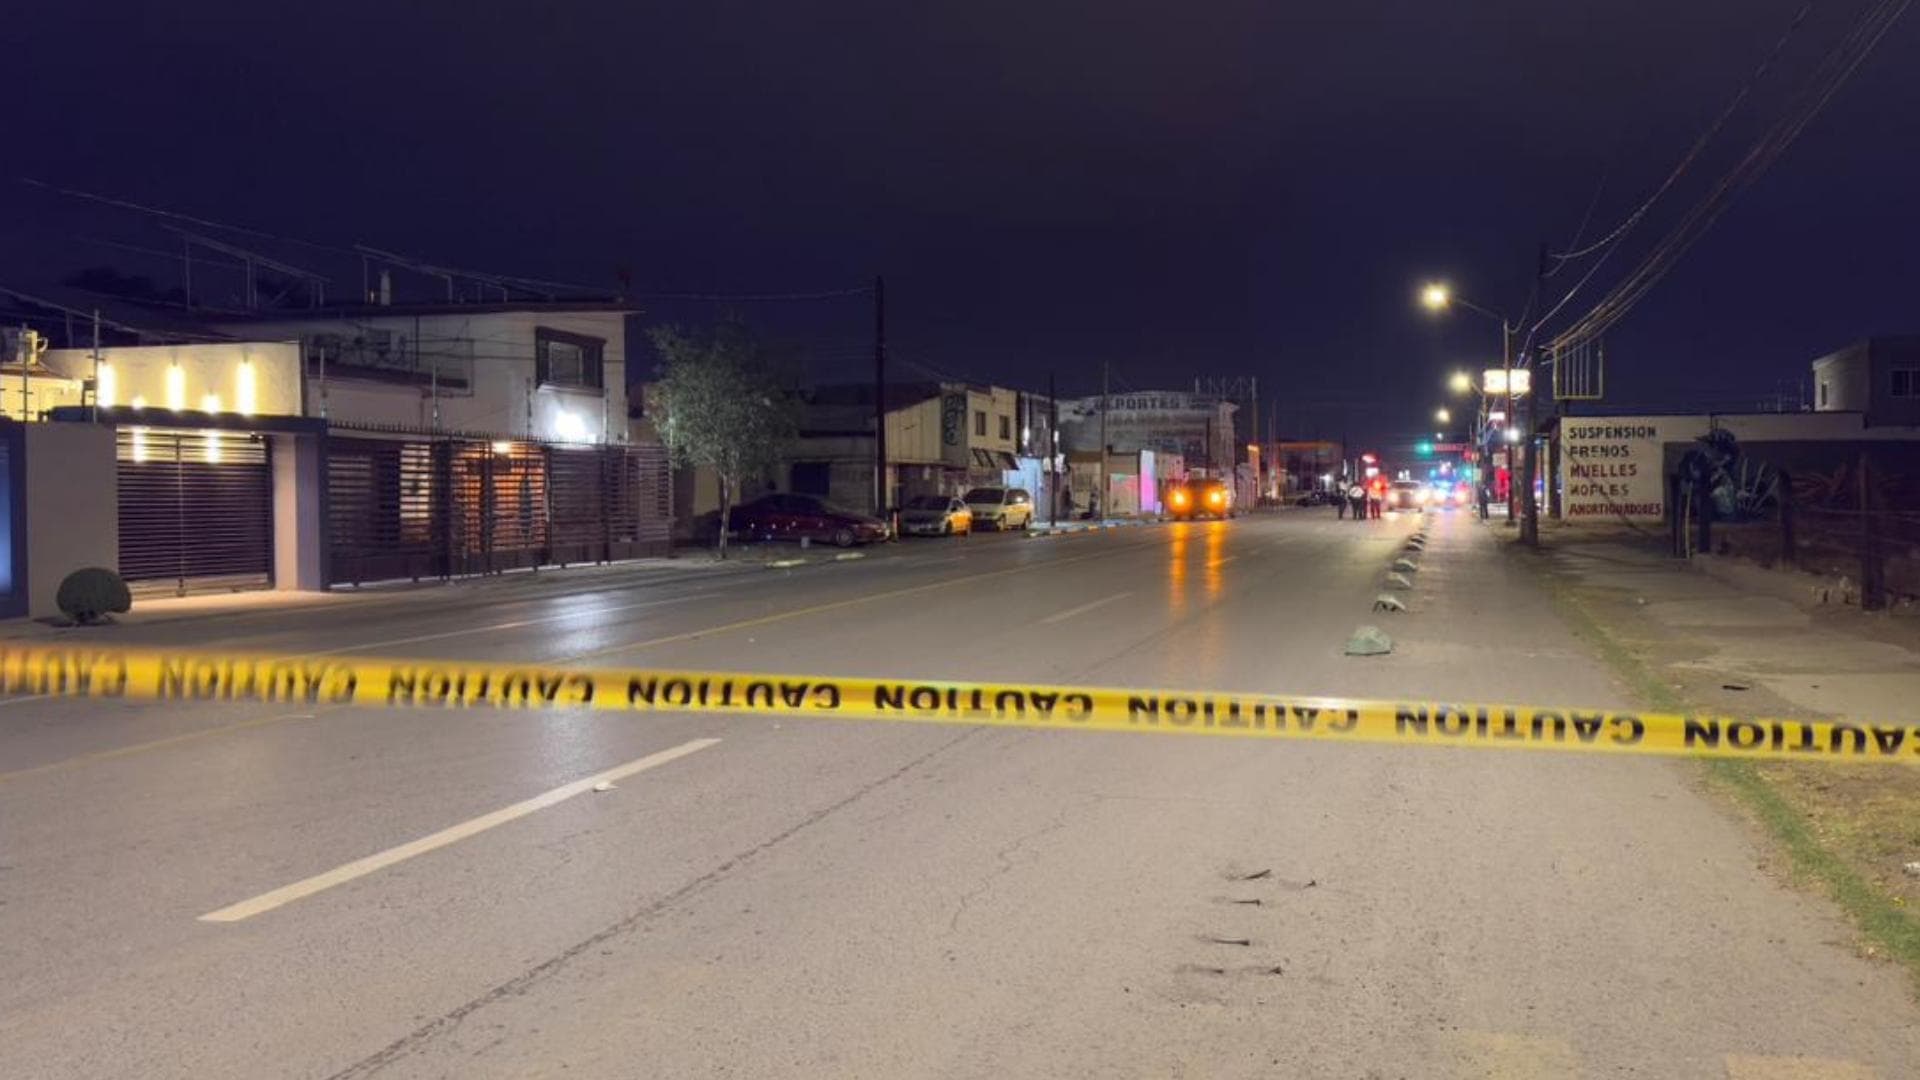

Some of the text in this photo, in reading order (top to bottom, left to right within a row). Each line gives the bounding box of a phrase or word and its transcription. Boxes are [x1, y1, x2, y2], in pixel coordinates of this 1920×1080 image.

[1569, 426, 1656, 439] SUSPENSION
[1570, 444, 1630, 458] FRENOS
[1570, 463, 1637, 478] MUELLES
[389, 669, 595, 707] CAUTION
[627, 676, 841, 709] CAUTION
[874, 684, 1093, 721] CAUTION
[1128, 695, 1358, 732] CAUTION
[1395, 704, 1644, 745] CAUTION
[1684, 720, 1920, 754] AUTION
